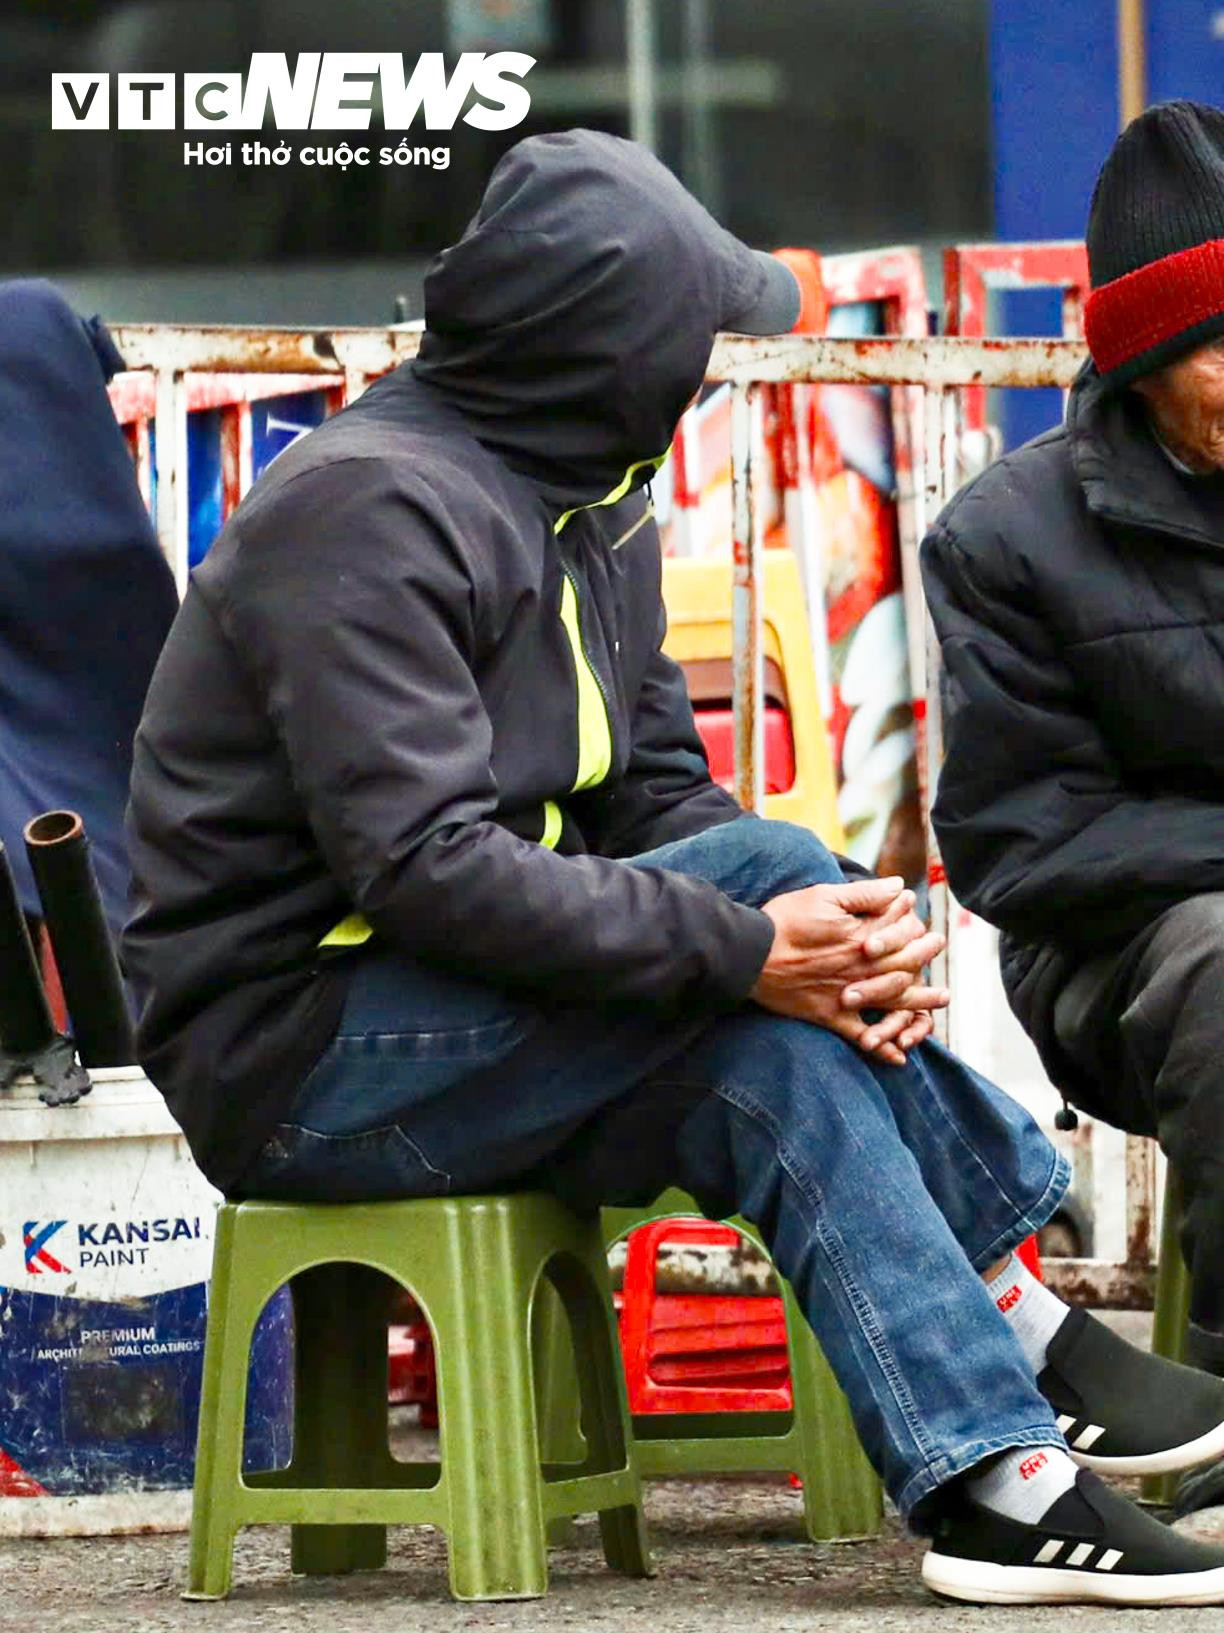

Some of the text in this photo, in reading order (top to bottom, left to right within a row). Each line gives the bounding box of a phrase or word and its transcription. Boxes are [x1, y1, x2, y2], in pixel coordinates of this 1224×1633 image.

[77, 1216, 201, 1247] KANSAI
[79, 1248, 150, 1268] PAINT
[80, 1327, 156, 1344] PREMIUM
[37, 1341, 201, 1361] ARCHITURAL COATINGS
